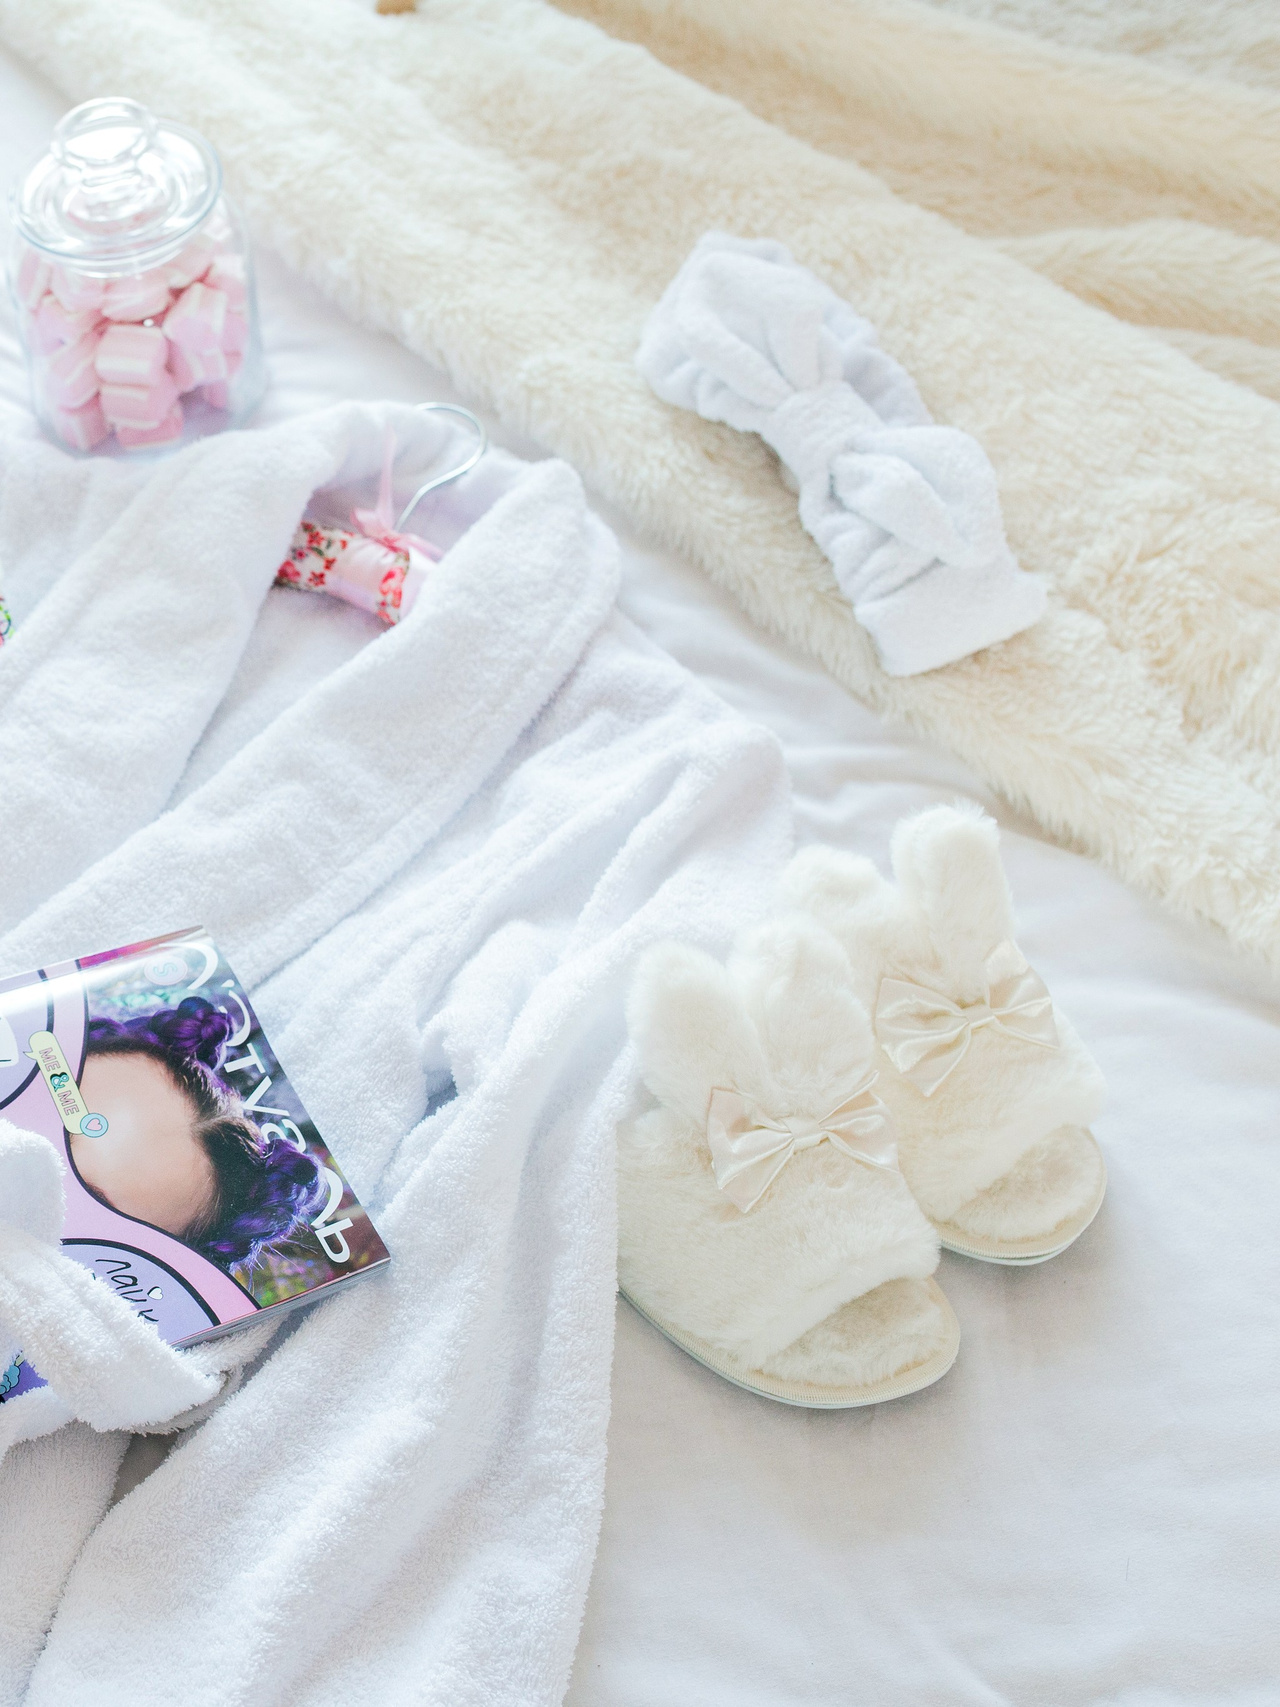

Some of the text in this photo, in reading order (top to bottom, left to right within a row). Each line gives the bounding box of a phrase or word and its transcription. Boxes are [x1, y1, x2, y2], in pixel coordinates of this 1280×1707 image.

[39, 1046, 80, 1116] ME & ME
